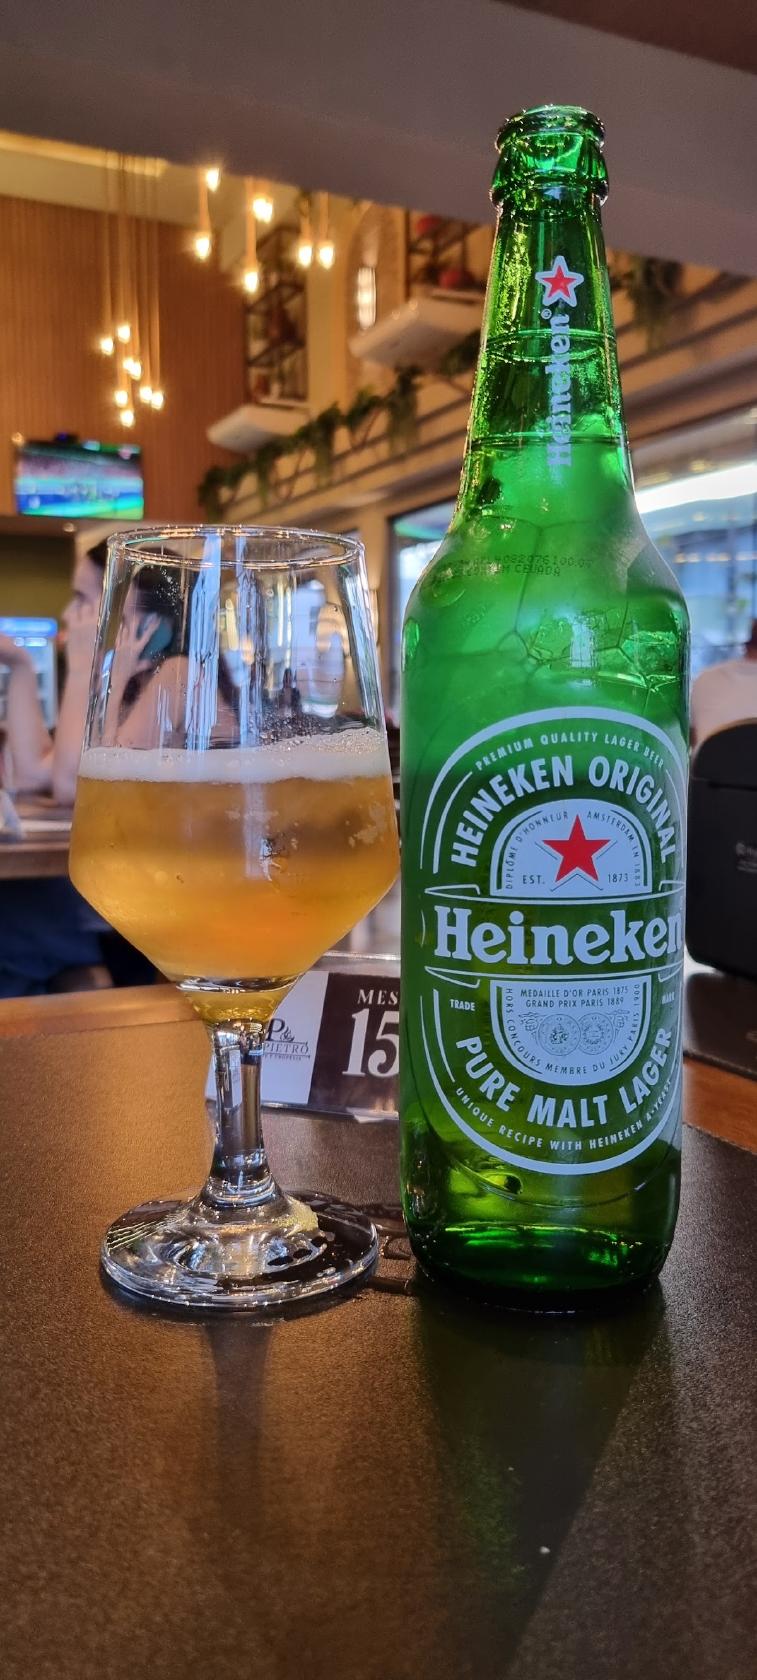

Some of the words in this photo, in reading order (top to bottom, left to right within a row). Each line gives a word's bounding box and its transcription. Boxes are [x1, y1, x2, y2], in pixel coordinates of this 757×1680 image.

[546, 313, 572, 466] Heineken
[475, 737, 534, 771] PREMIUM
[540, 732, 598, 745] QUALITY
[604, 734, 640, 752] LAGER
[643, 746, 664, 769] BEER
[451, 755, 574, 867] HEINEKEN
[588, 756, 675, 864] ORIGINAL
[587, 810, 635, 842] AMSTERDAM
[522, 874, 546, 885] EST.
[608, 873, 629, 884] 1873
[434, 905, 682, 965] Heineken
[356, 988, 399, 1006] MES
[449, 998, 476, 1011] TRADE
[505, 988, 514, 1014] HORS
[526, 999, 555, 1008] GRAND
[558, 999, 577, 1008] PRIX
[581, 998, 603, 1008] PARIS
[563, 988, 583, 998] D'OR
[587, 987, 609, 997] PARIS
[342, 1008, 400, 1078] 15
[506, 1019, 541, 1067] CONCOURS
[456, 1036, 521, 1112] PURE
[527, 1094, 608, 1128] MALT
[618, 1028, 672, 1114] LAGER
[545, 1063, 587, 1075] MEMBRE
[592, 1061, 605, 1072] DU
[456, 1087, 494, 1127] UNIQUE
[498, 1124, 543, 1148] RECIPE
[550, 1140, 582, 1150] WITH
[589, 1119, 643, 1149] HEINEKEN
